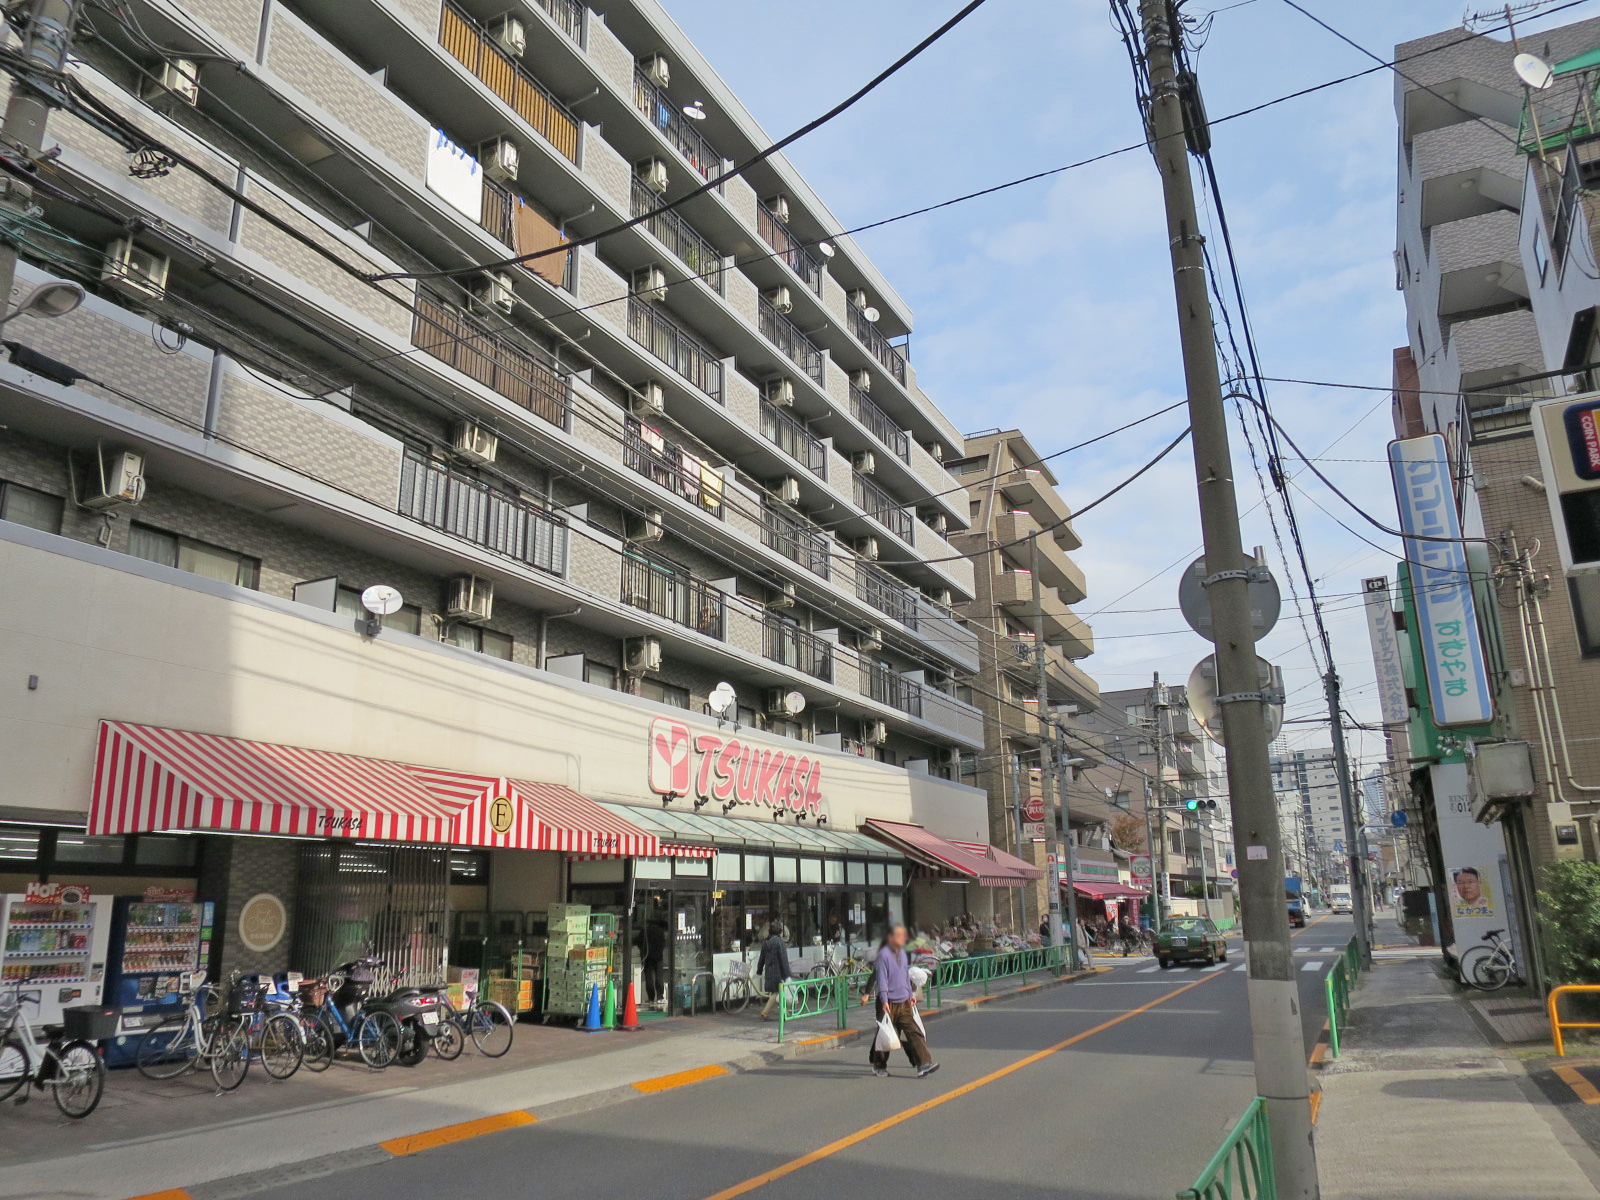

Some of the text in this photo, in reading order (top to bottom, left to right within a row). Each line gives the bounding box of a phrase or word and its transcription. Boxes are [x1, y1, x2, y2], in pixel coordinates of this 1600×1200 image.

[1581, 415, 1600, 467] COIN PARK
[1407, 459, 1459, 604] クリーニング
[695, 735, 822, 815] TSUKASA
[318, 815, 364, 830] TSUKASA
[593, 838, 619, 848] TSUKASA
[27, 882, 59, 898] HOT
